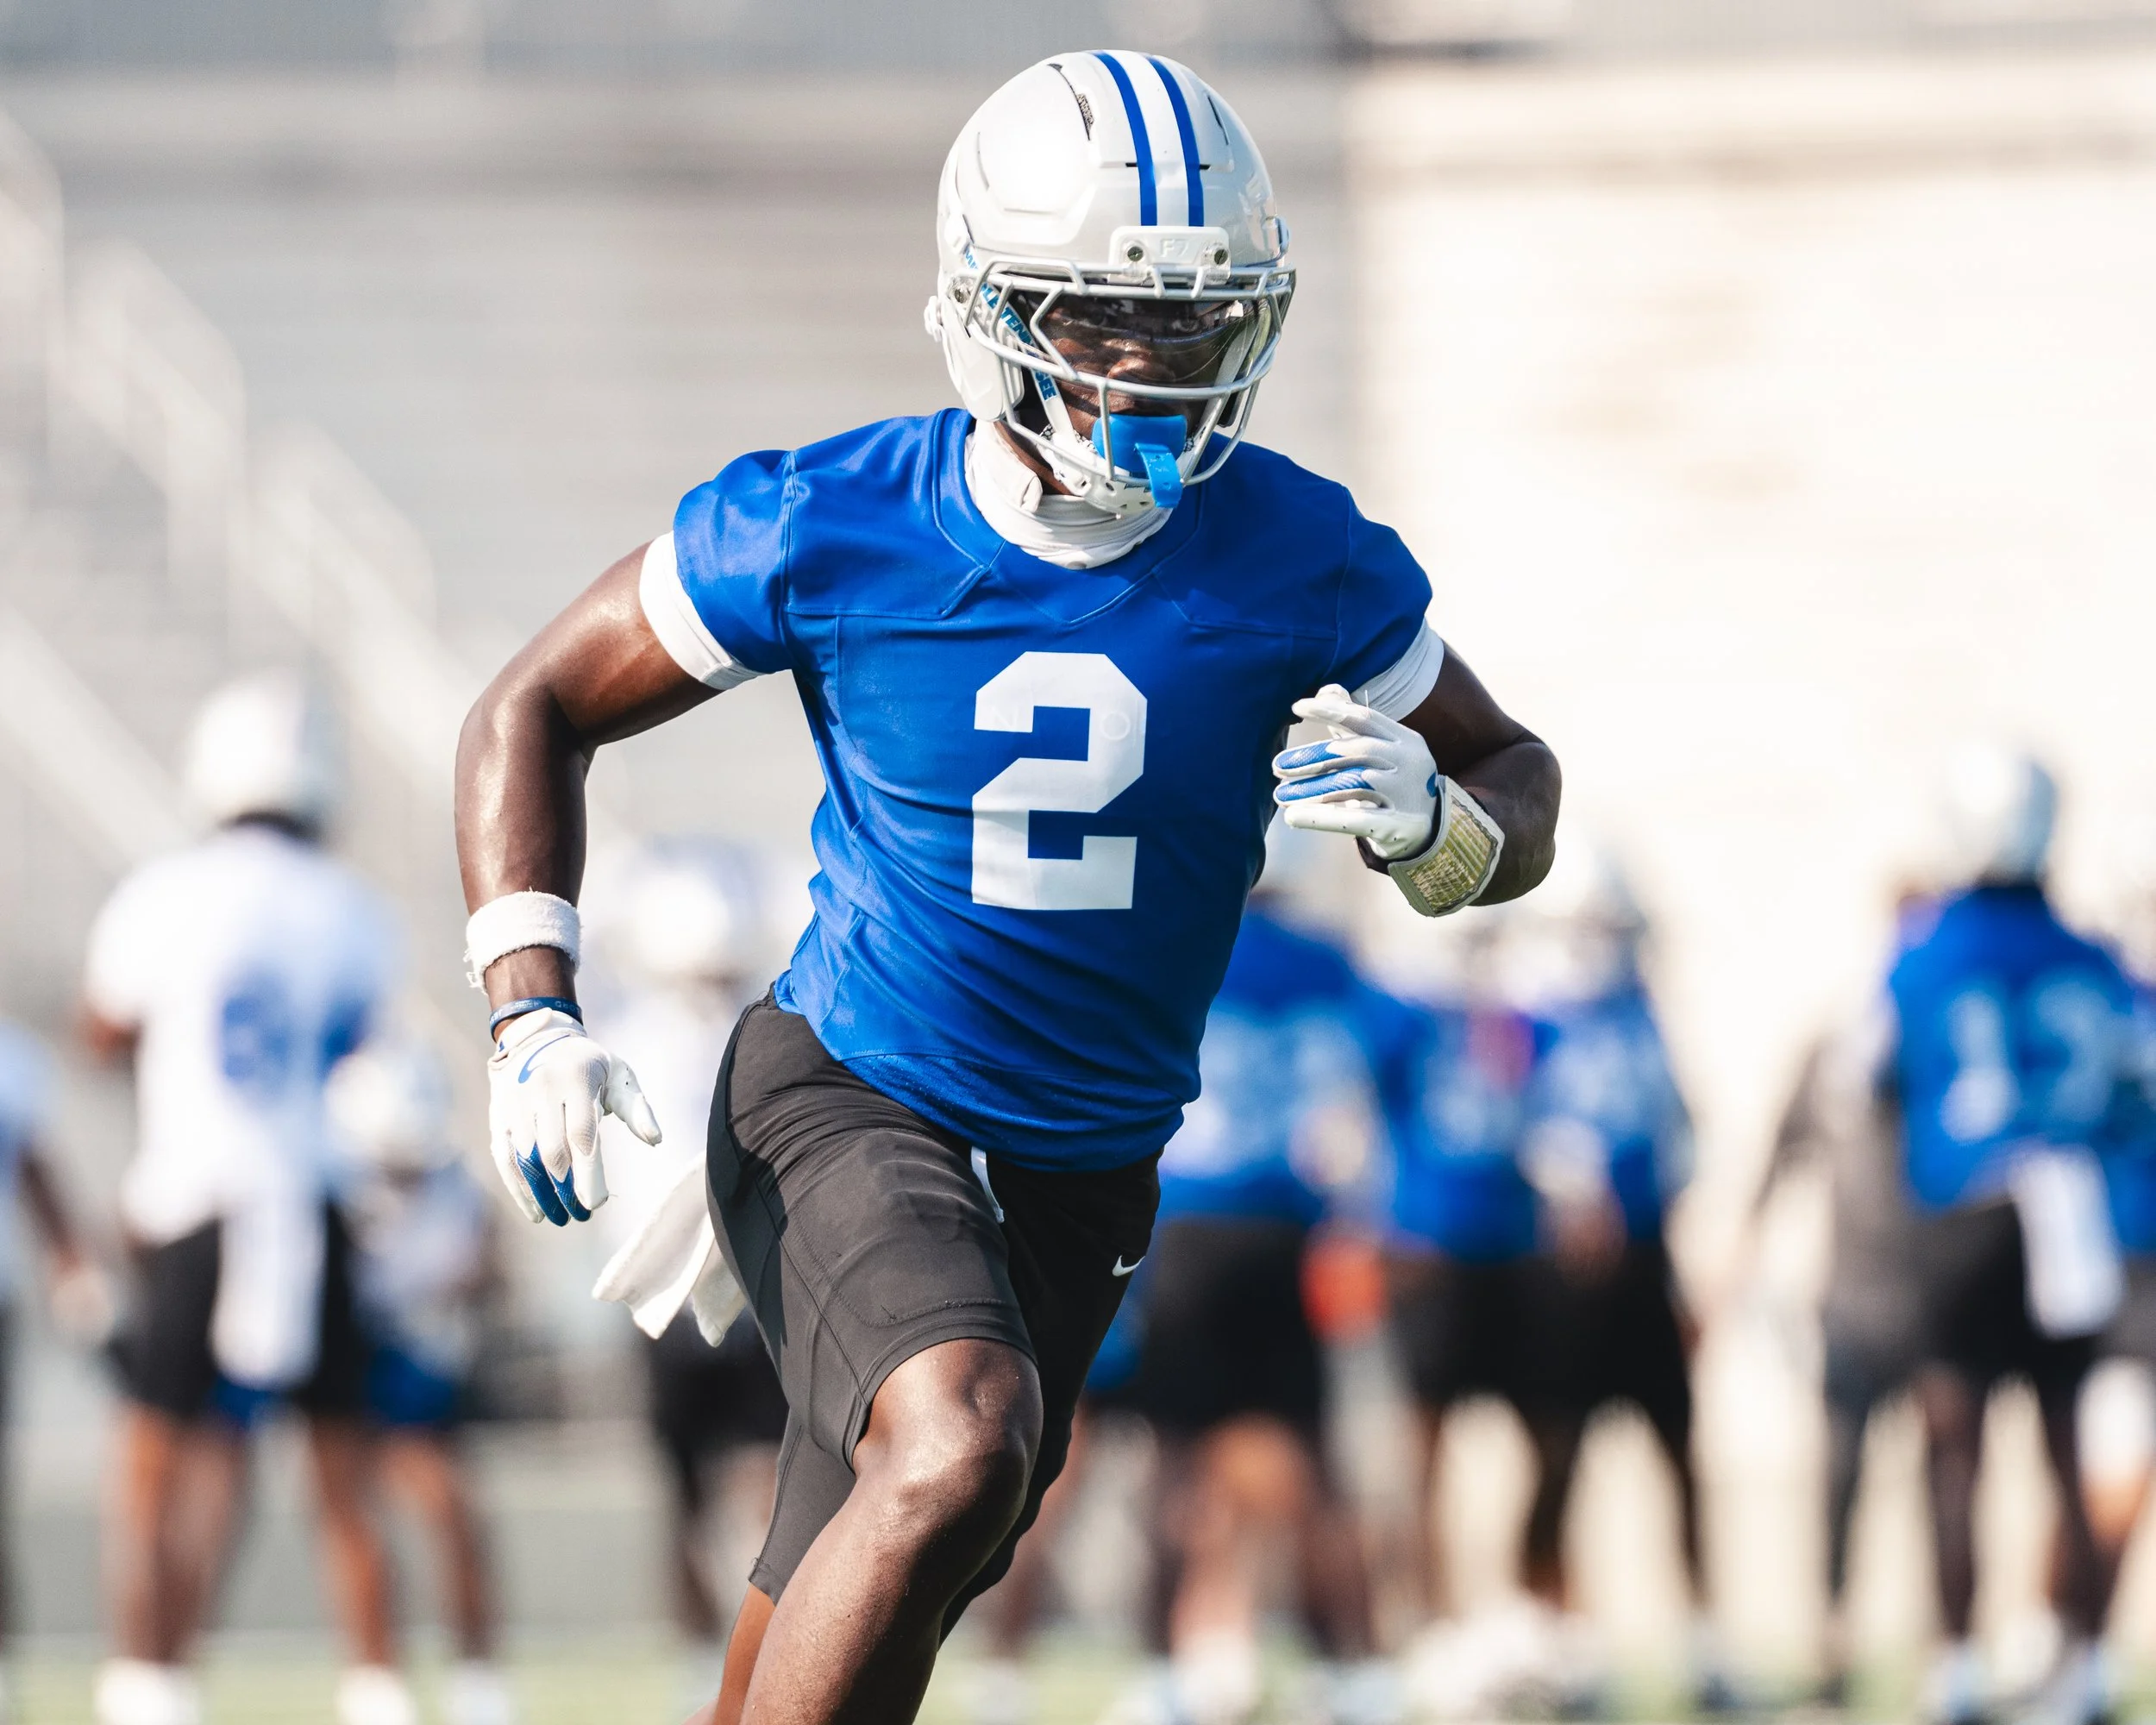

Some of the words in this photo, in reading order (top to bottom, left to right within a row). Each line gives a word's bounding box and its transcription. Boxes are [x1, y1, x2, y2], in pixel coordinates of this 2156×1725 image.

[1161, 238, 1190, 257] F7
[965, 248, 1000, 309] MILE
[1000, 307, 1057, 401] TENNSEE
[971, 651, 1148, 910] 2
